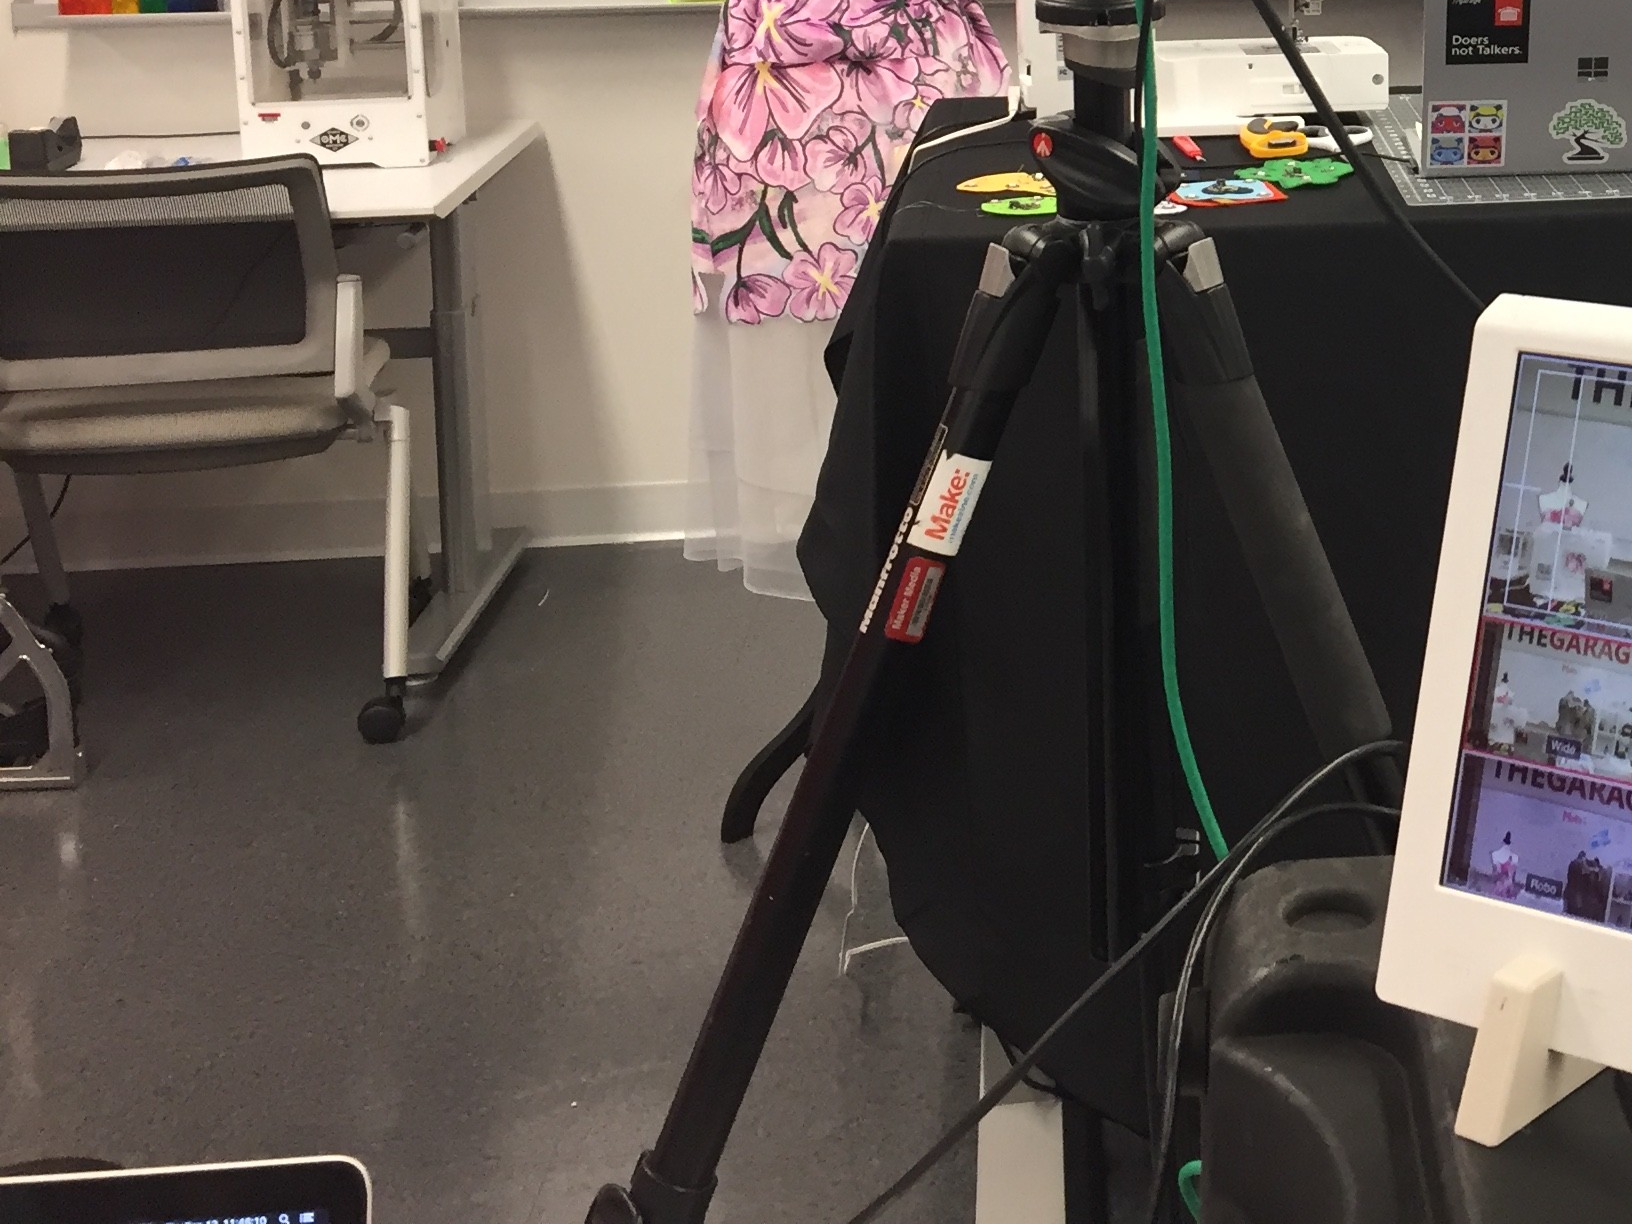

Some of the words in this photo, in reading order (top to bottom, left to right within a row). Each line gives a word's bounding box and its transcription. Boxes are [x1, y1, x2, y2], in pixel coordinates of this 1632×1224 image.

[1452, 35, 1489, 45] Doers
[1451, 46, 1474, 55] not
[923, 467, 971, 541] Make:
[1550, 739, 1577, 755] Wide
[1530, 877, 1558, 896] Robo
